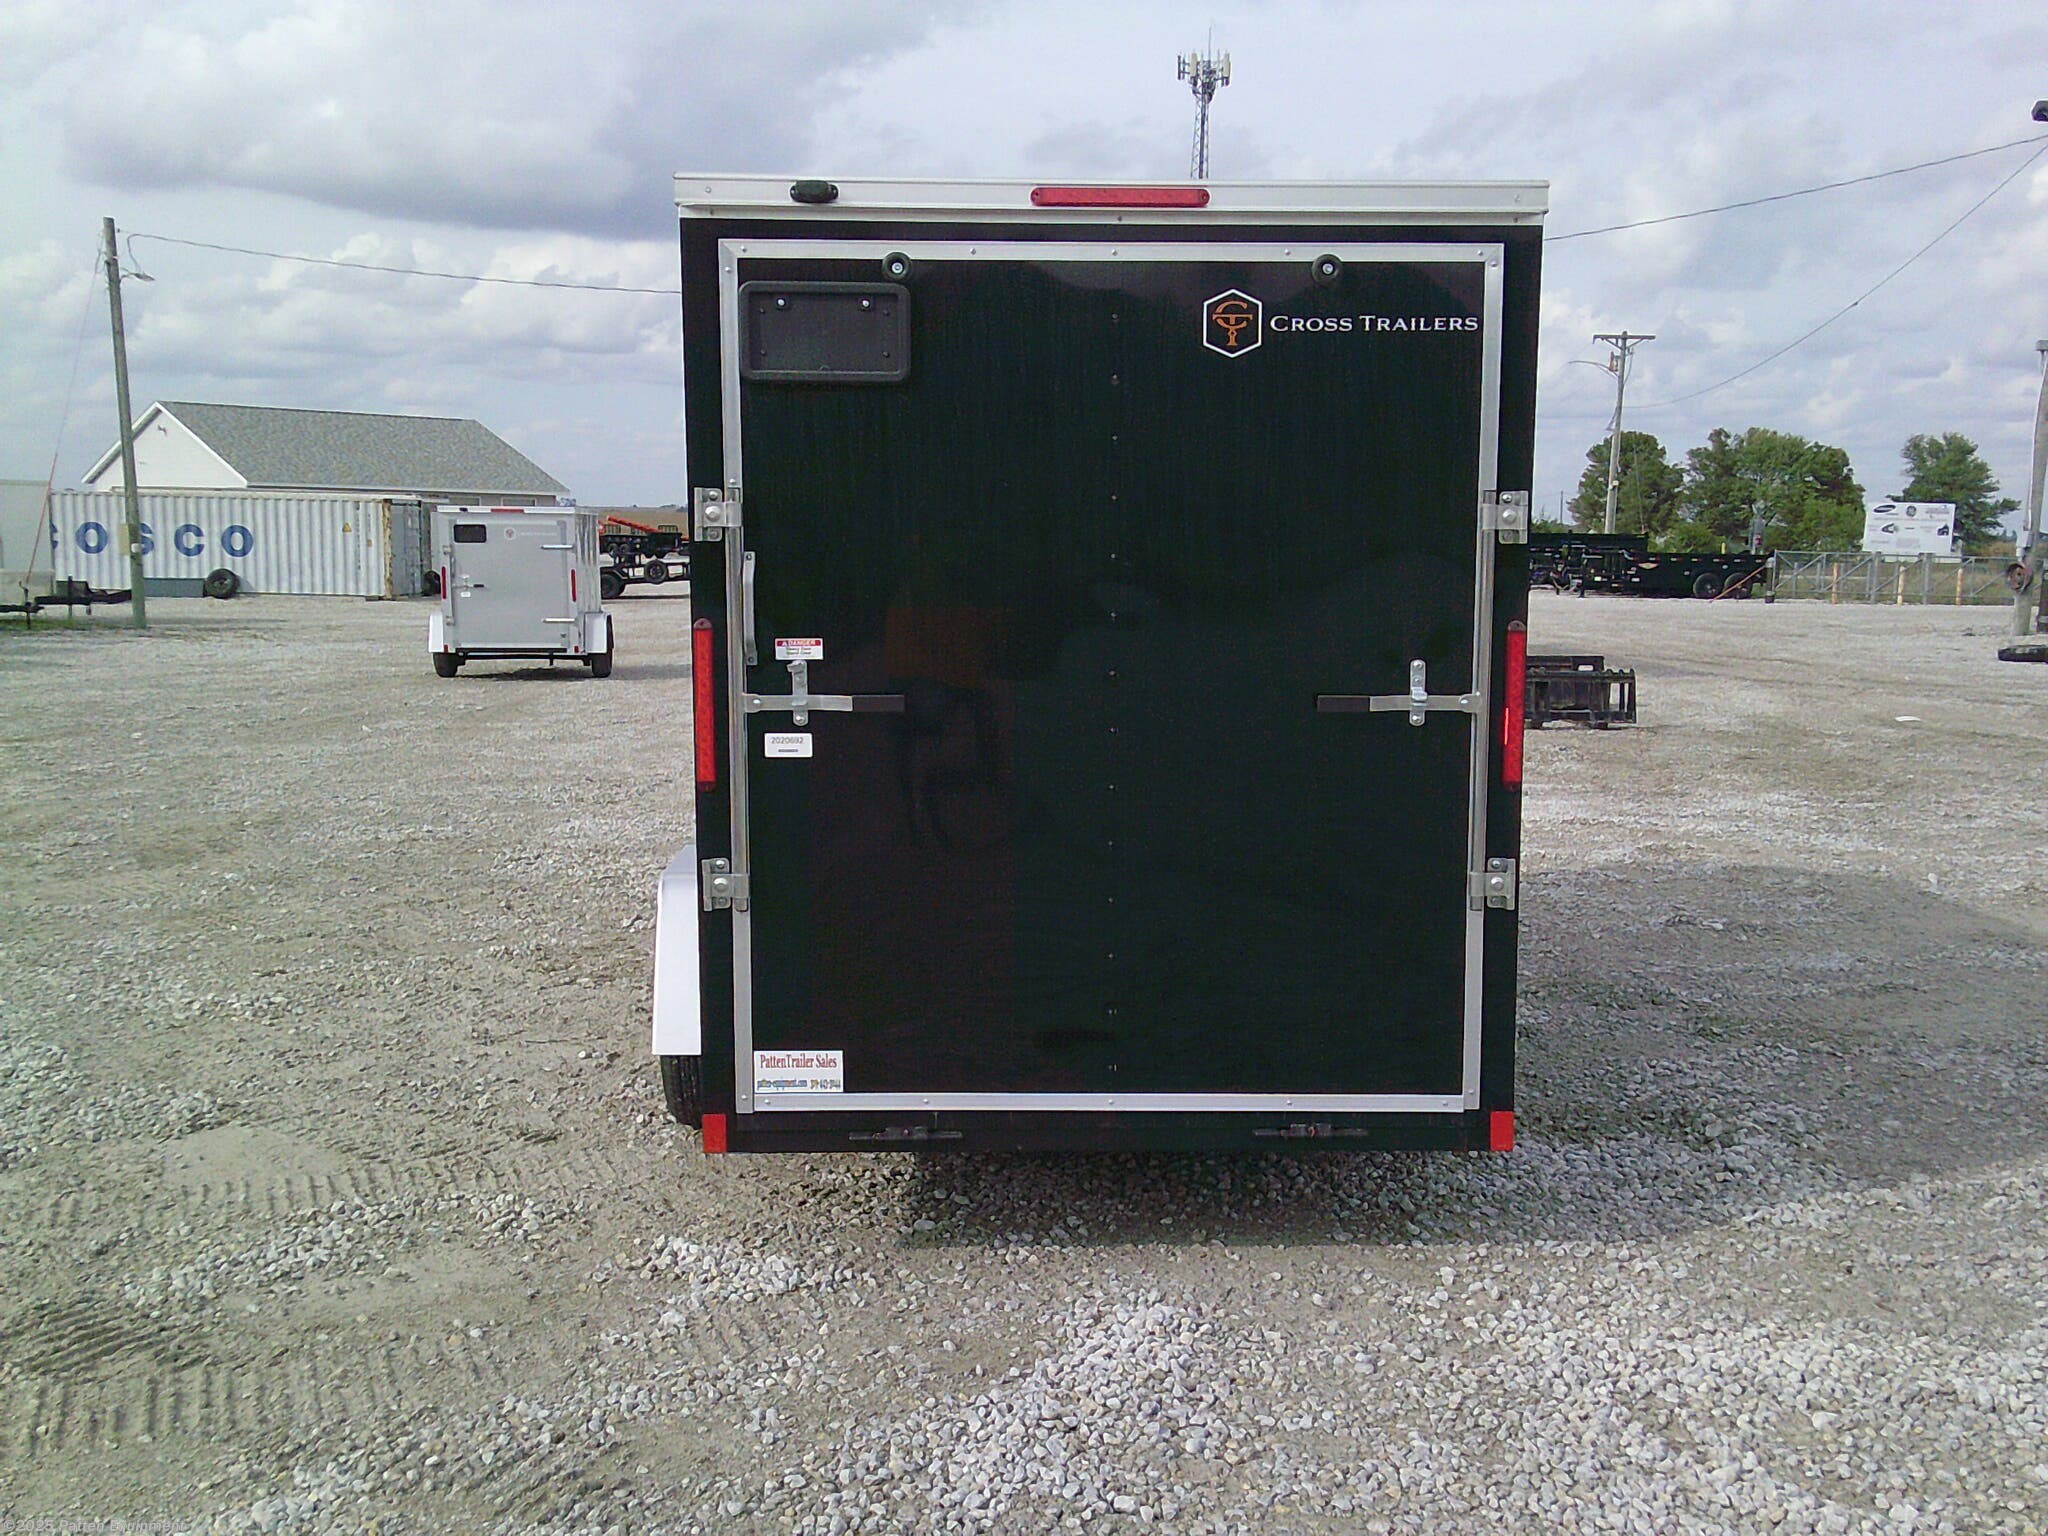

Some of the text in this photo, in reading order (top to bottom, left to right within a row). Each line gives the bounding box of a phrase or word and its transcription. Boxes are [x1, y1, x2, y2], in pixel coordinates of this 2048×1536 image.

[1269, 314, 1479, 332] CROSS TRAILERS
[815, 1053, 837, 1069] Sales
